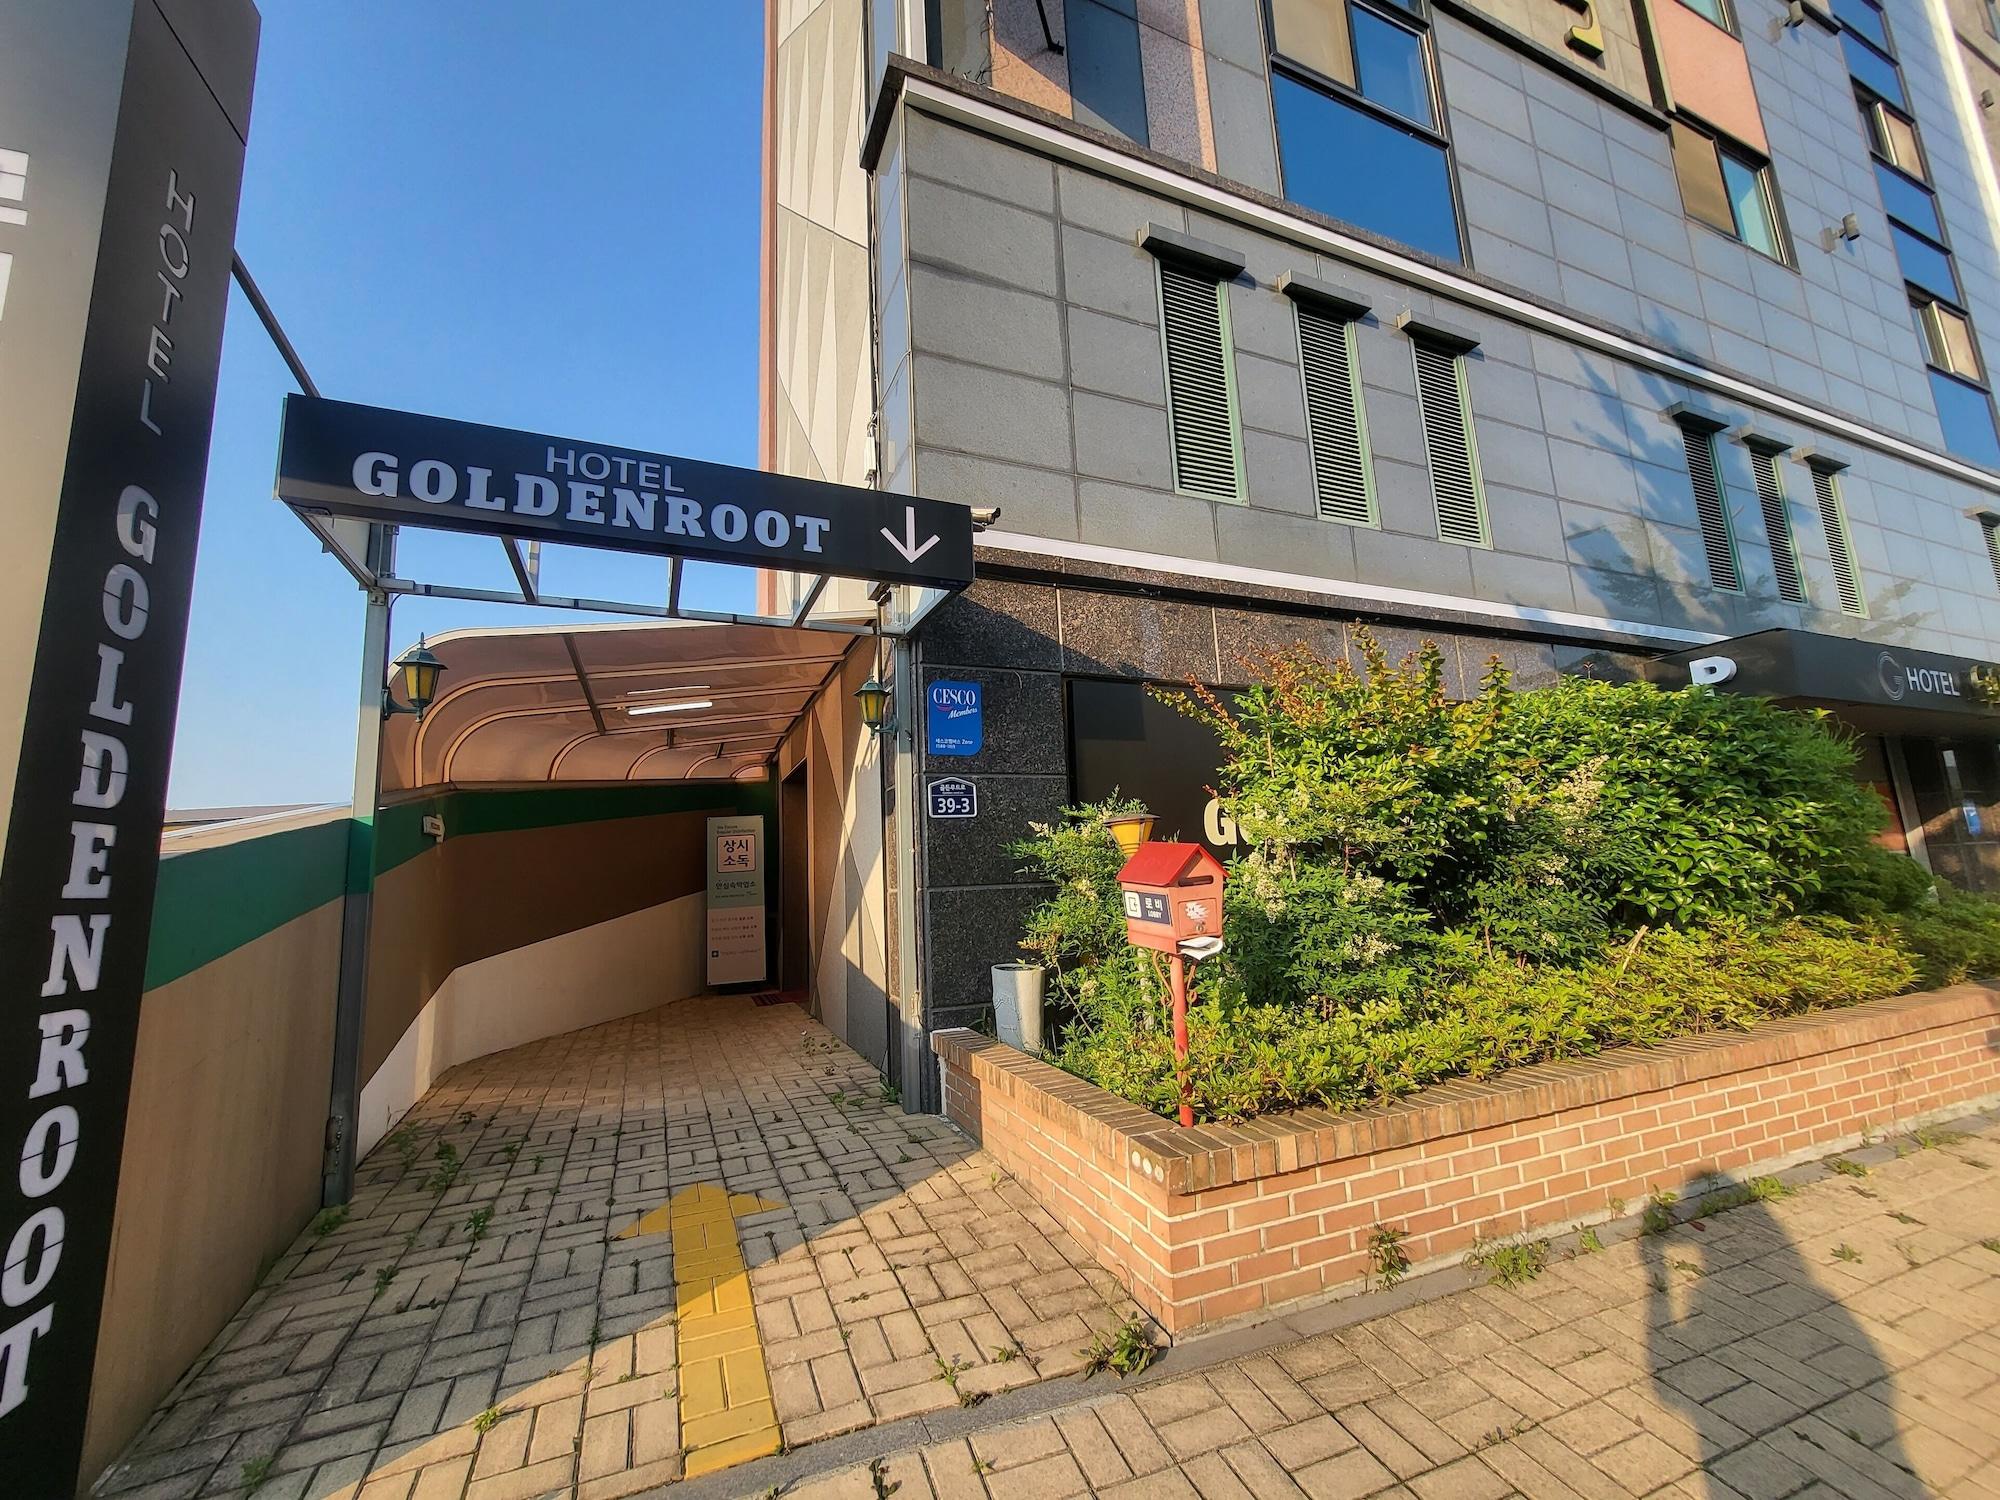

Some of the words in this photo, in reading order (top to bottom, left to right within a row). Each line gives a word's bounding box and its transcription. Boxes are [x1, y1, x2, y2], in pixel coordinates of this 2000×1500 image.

[139, 168, 196, 437] HOTEL
[547, 445, 685, 494] HOTEL
[350, 450, 832, 554] GOLDENROOT
[1688, 655, 1738, 697] P
[1905, 666, 1961, 697] HOTEL
[933, 688, 976, 706] CESCO
[947, 705, 978, 720] Members
[937, 797, 970, 814] 39-3
[722, 854, 749, 867] 소독
[723, 839, 749, 853] 상시
[0, 483, 161, 1420] GOLDENROOT
